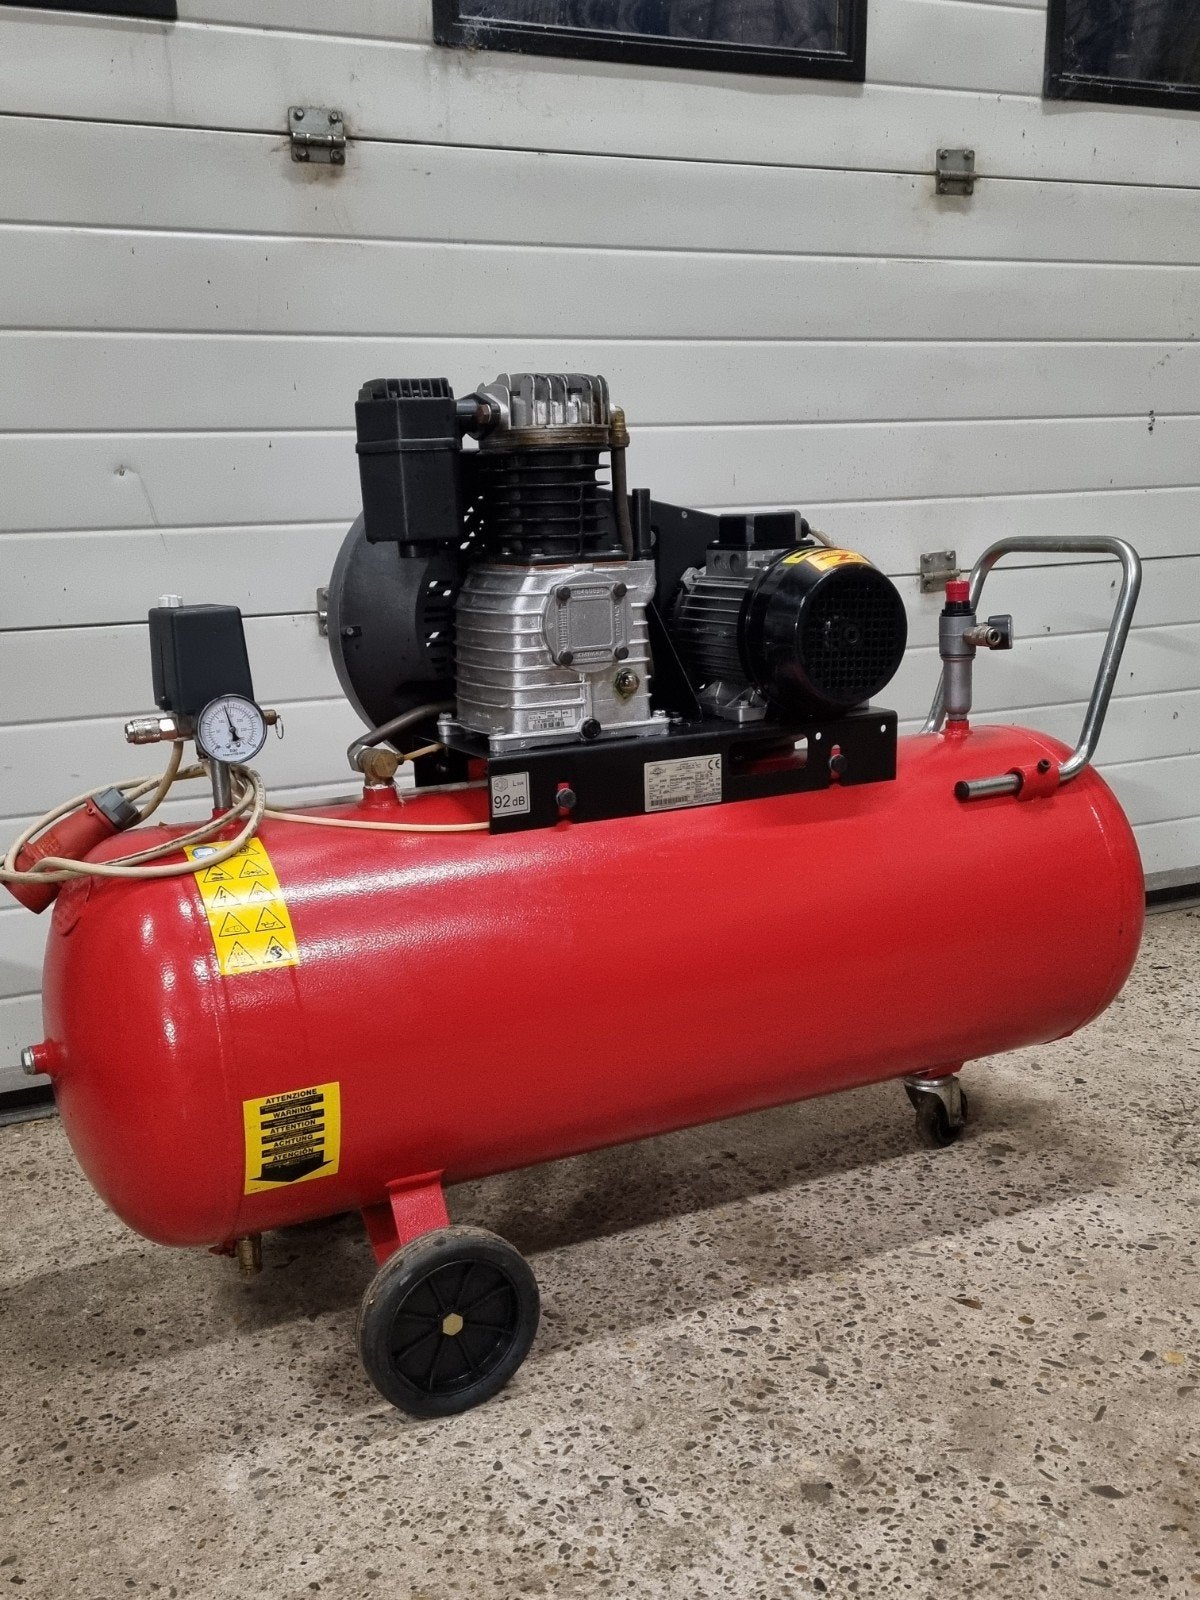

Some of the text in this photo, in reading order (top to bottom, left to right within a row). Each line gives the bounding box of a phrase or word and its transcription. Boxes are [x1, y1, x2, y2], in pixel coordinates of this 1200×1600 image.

[494, 795, 525, 808] 92 dB
[266, 1088, 317, 1104] ATTENZIONE
[273, 1105, 312, 1118] WARNING
[270, 1119, 316, 1134] ATTENTION
[273, 1134, 313, 1148] ACHTUNG
